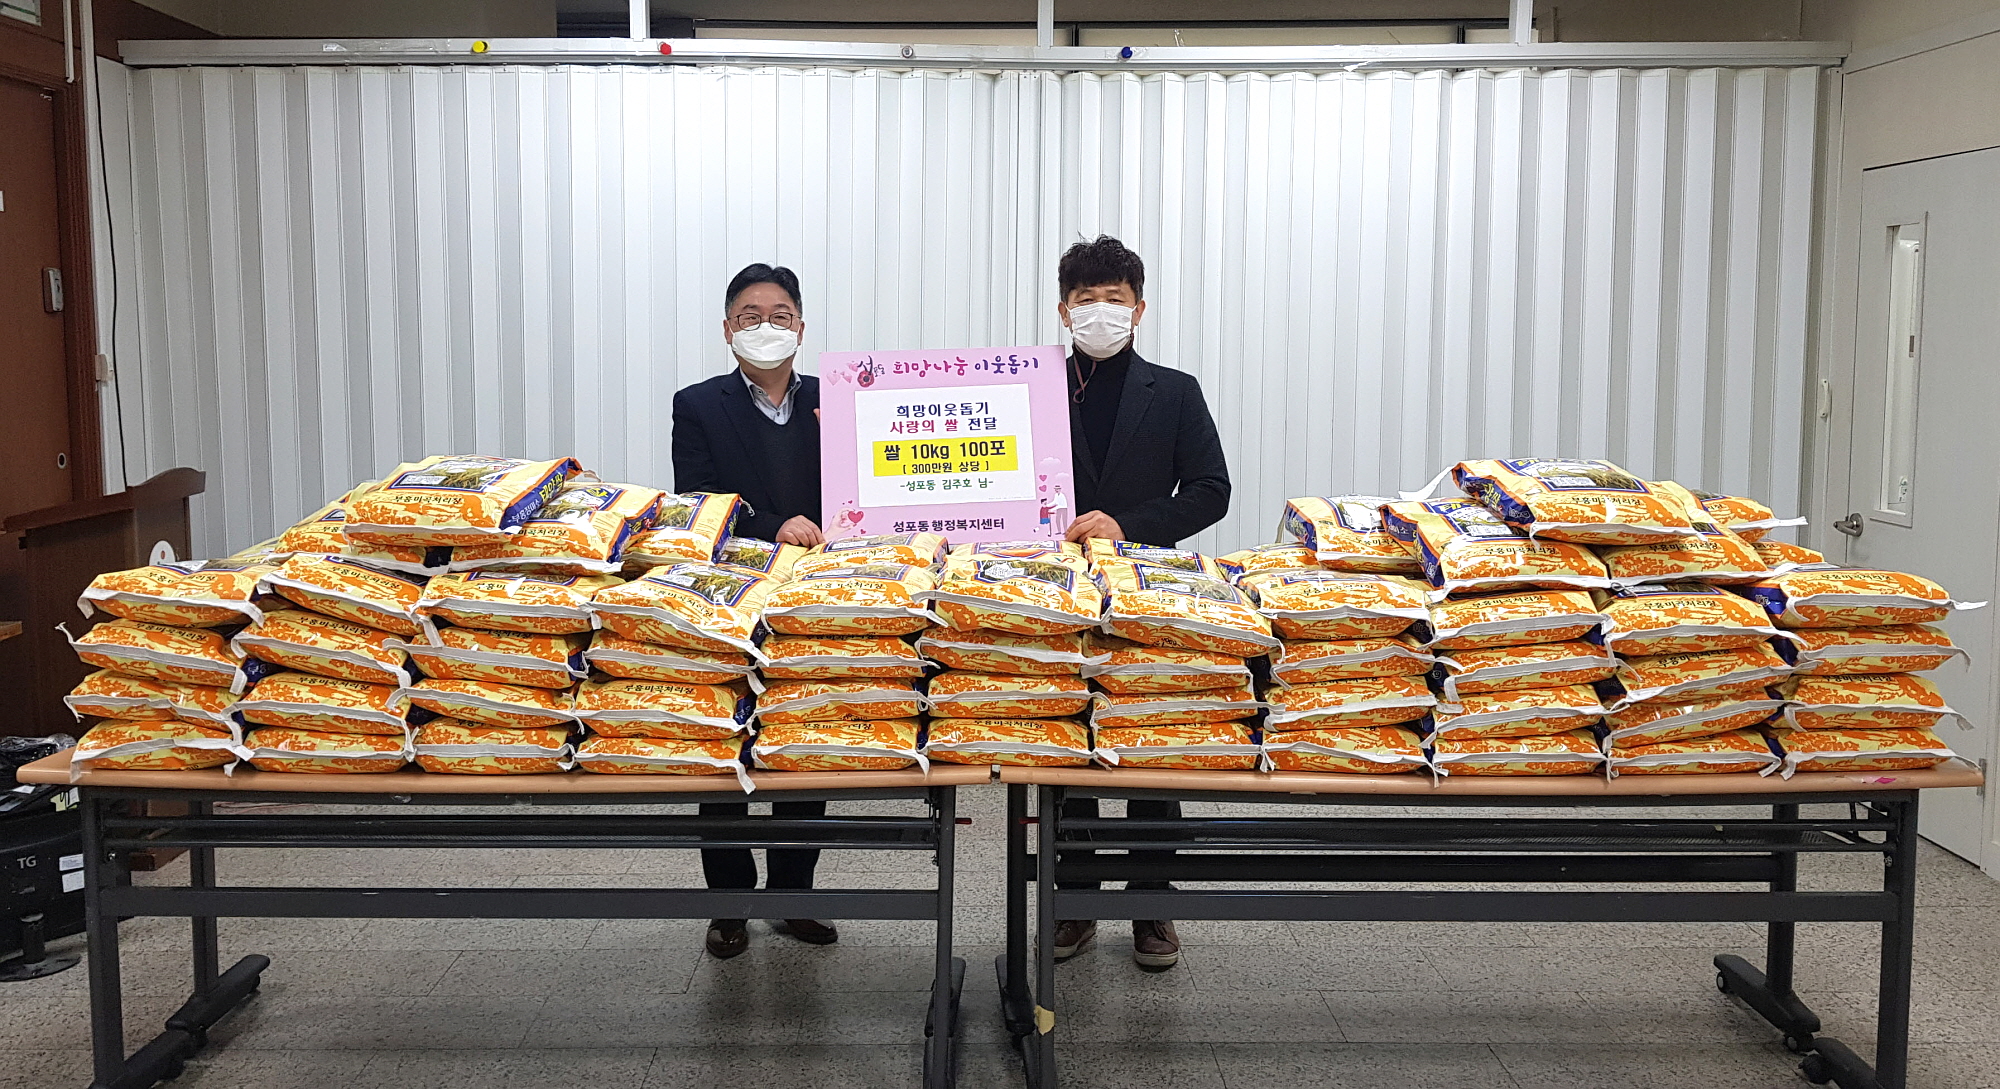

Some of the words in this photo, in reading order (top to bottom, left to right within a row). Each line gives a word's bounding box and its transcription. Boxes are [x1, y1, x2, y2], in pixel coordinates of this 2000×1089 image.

[893, 359, 968, 377] 희망나눔
[974, 355, 1039, 375] 이웃돕기
[896, 402, 989, 418] 희망이웃돕기
[889, 420, 935, 434] 사랑의
[944, 419, 958, 432] 쌀
[967, 417, 997, 431] 전달
[884, 445, 901, 461] 쌀
[911, 444, 950, 460] 10kg
[959, 440, 1006, 457] 100포
[942, 479, 973, 491] 김주호
[625, 684, 694, 694] 부흥미곡처리장
[17, 855, 37, 869] TG
